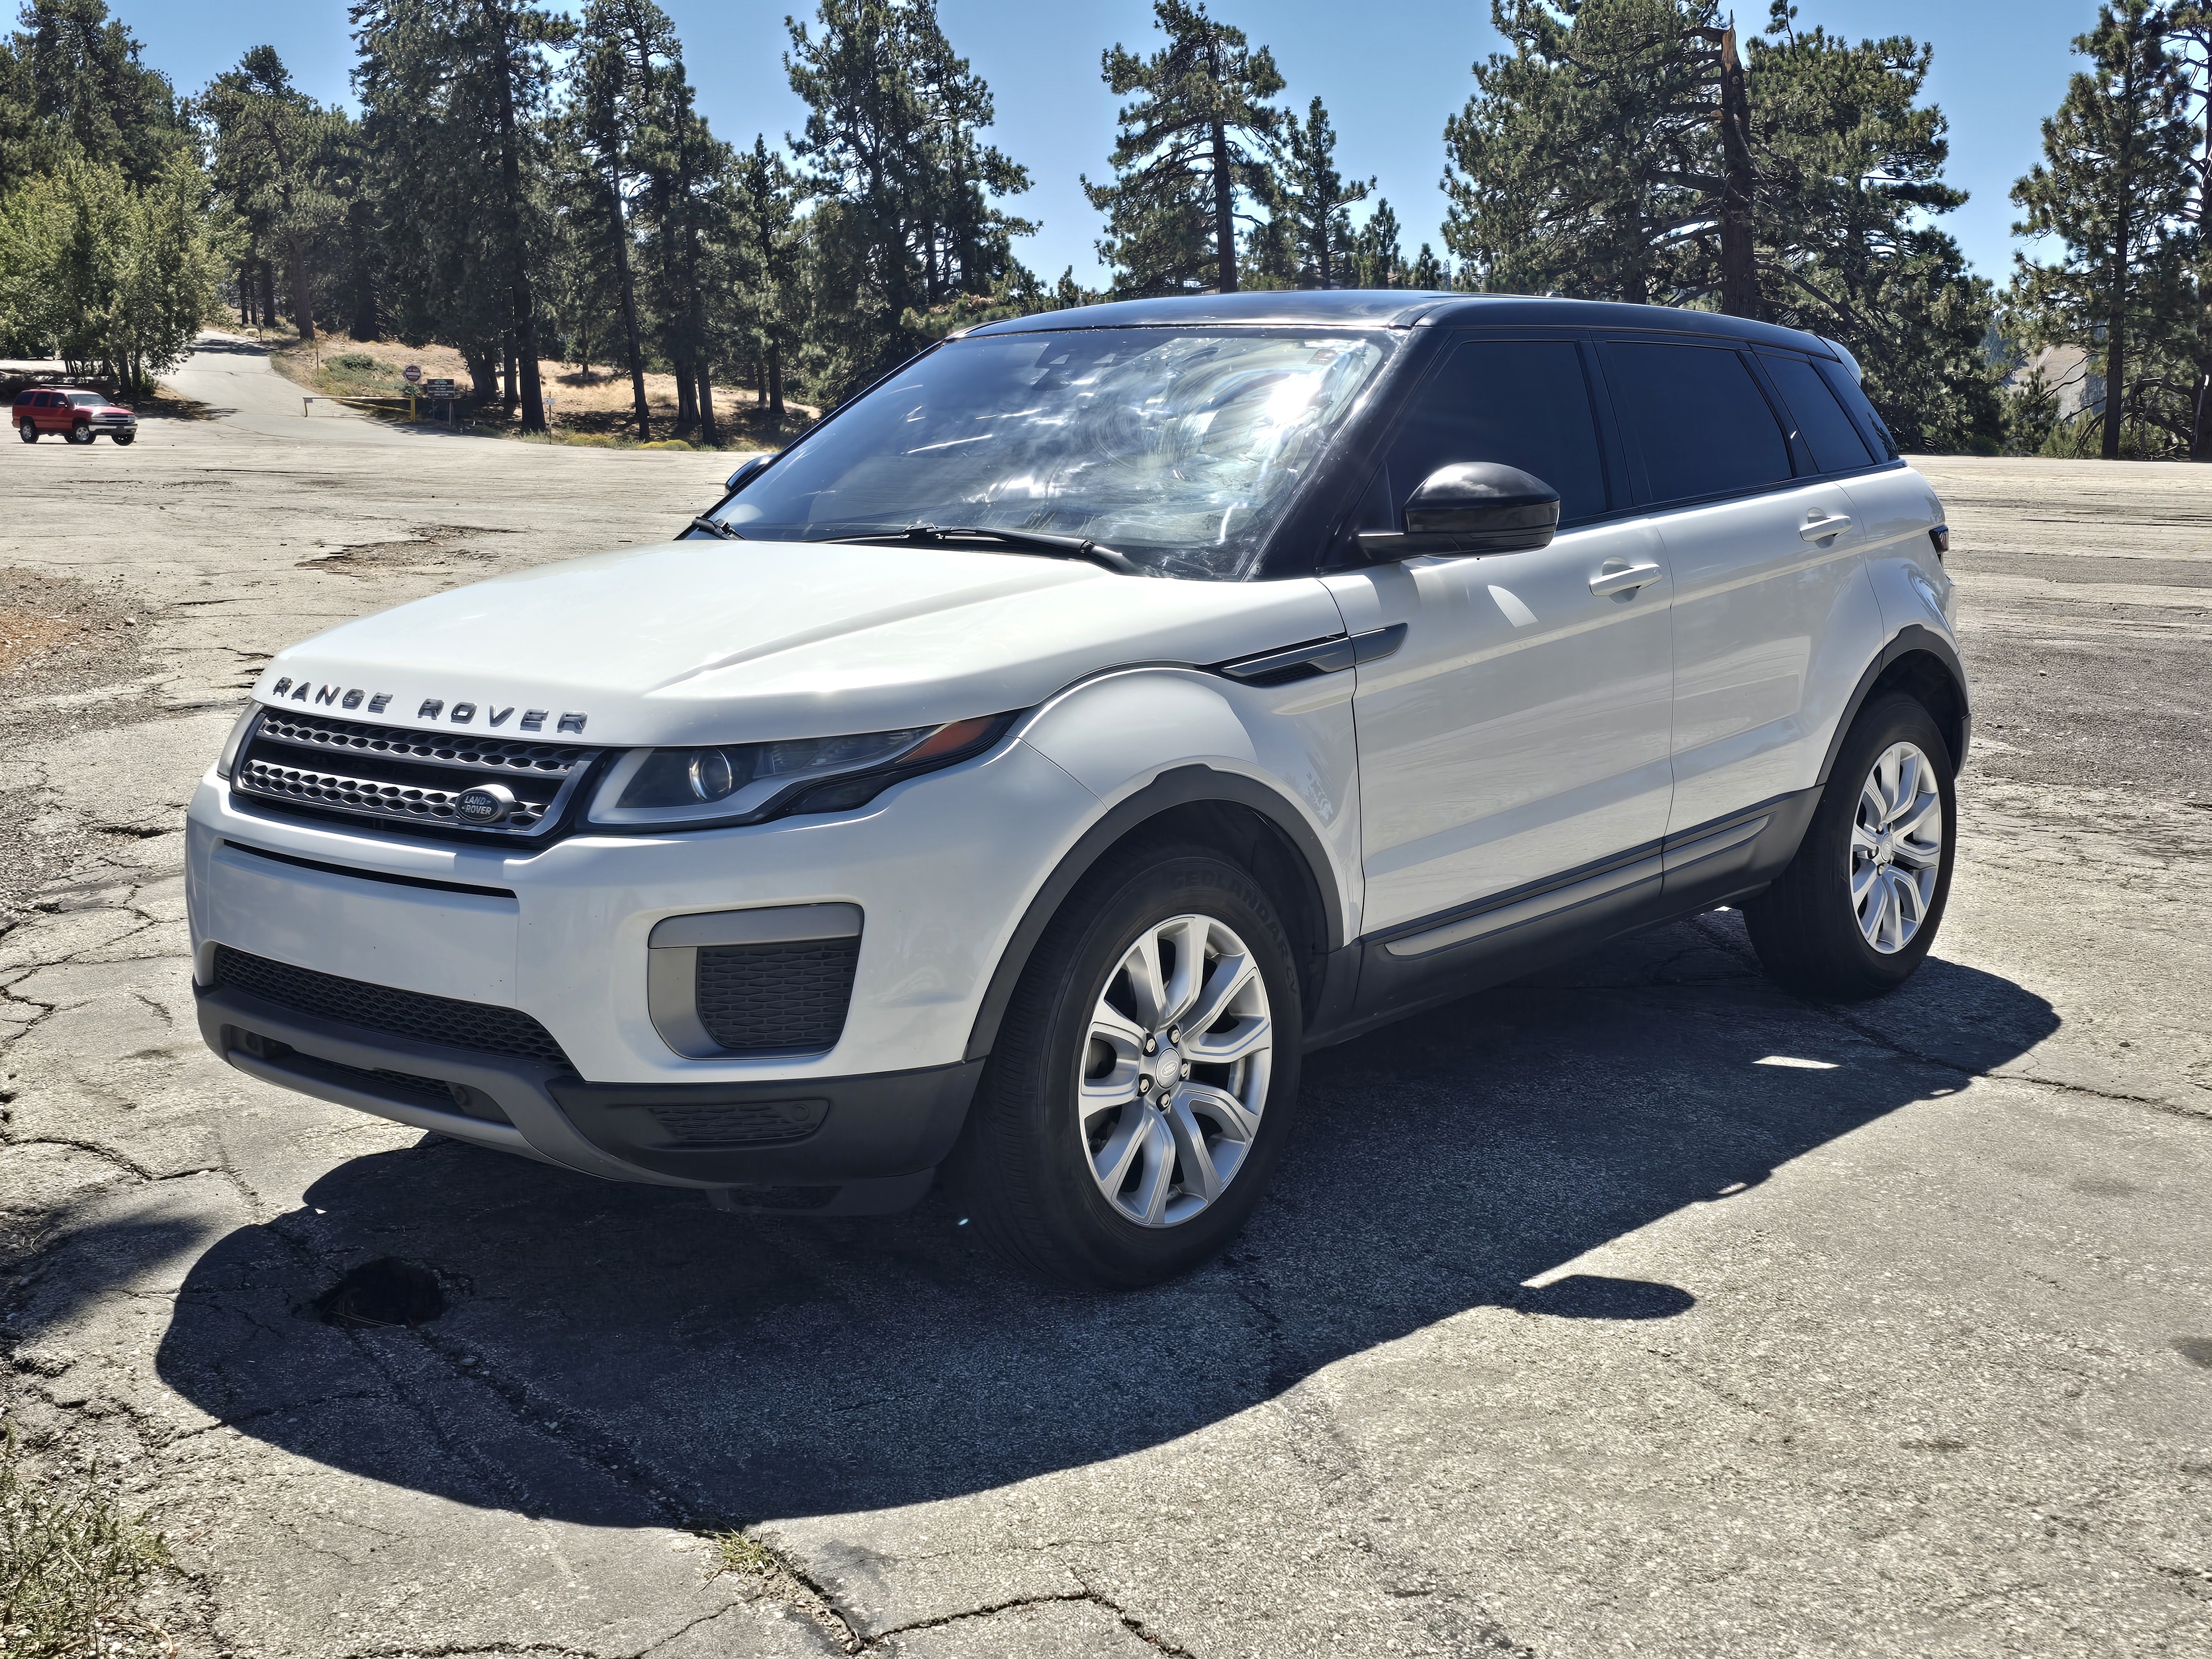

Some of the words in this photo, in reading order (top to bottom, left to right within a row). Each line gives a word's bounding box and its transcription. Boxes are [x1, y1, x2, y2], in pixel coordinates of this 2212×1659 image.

[273, 676, 393, 714] RANGE
[418, 698, 588, 734] ROVER
[465, 795, 487, 805] LAND
[465, 805, 492, 815] ROVER
